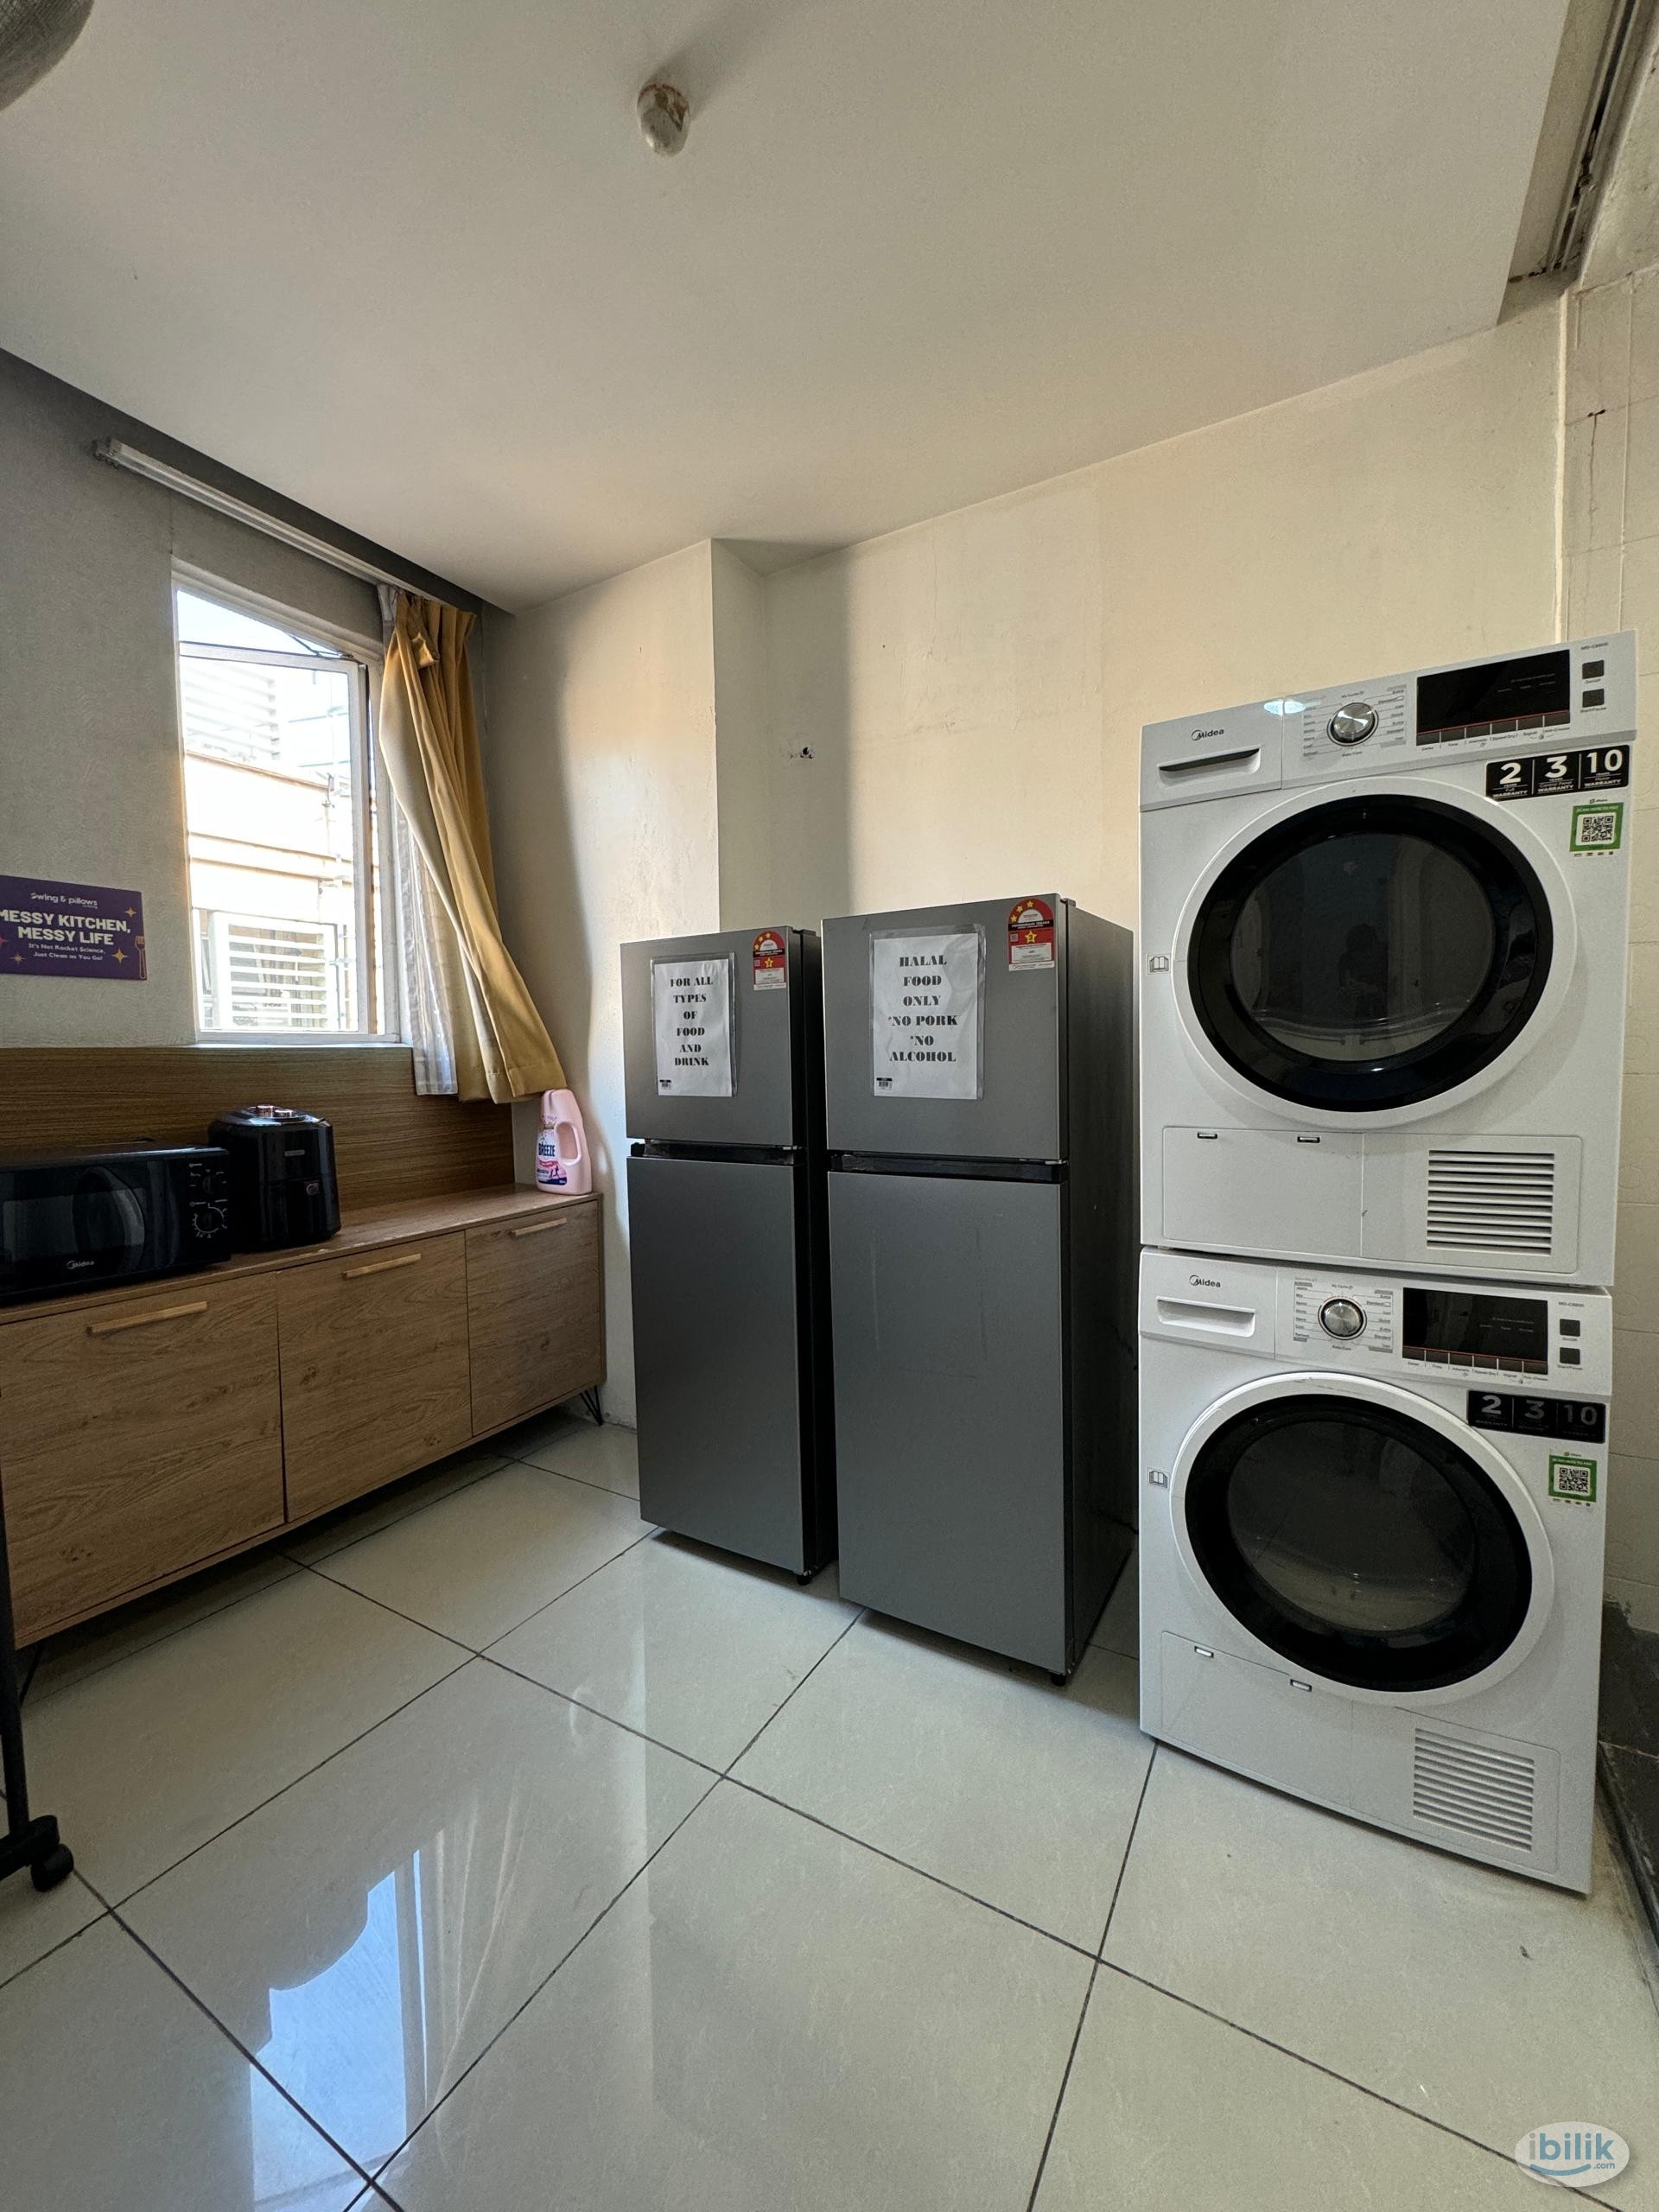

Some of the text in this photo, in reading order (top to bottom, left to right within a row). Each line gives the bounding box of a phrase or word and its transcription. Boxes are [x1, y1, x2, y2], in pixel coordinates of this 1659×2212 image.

[1192, 728, 1224, 741] Midea
[1545, 755, 1567, 779] 3
[1586, 749, 1623, 773] 10
[1499, 762, 1522, 785] 2
[1584, 779, 1622, 787] WARRANTY
[30, 892, 59, 904] Swing
[68, 897, 98, 906] pillows
[0, 909, 130, 933] MESSY KITCHEN,
[18, 926, 114, 945] MESSY LIFE
[899, 955, 947, 967] HALAL
[671, 976, 714, 988] FOR ALL
[903, 976, 942, 987] FOOD
[673, 994, 707, 1003] TYPES
[903, 995, 942, 1007] ONLY
[683, 1011, 698, 1020] OF
[916, 1014, 958, 1026] PORK
[677, 1027, 705, 1036] FOOD
[679, 1044, 702, 1052] AND
[675, 1058, 709, 1066] DRINK
[889, 1052, 957, 1062] ALCOHOL
[1189, 1274, 1221, 1288] Midea
[1481, 1395, 1502, 1415] 2
[1524, 1399, 1545, 1420] 3
[1563, 1404, 1598, 1426] 10
